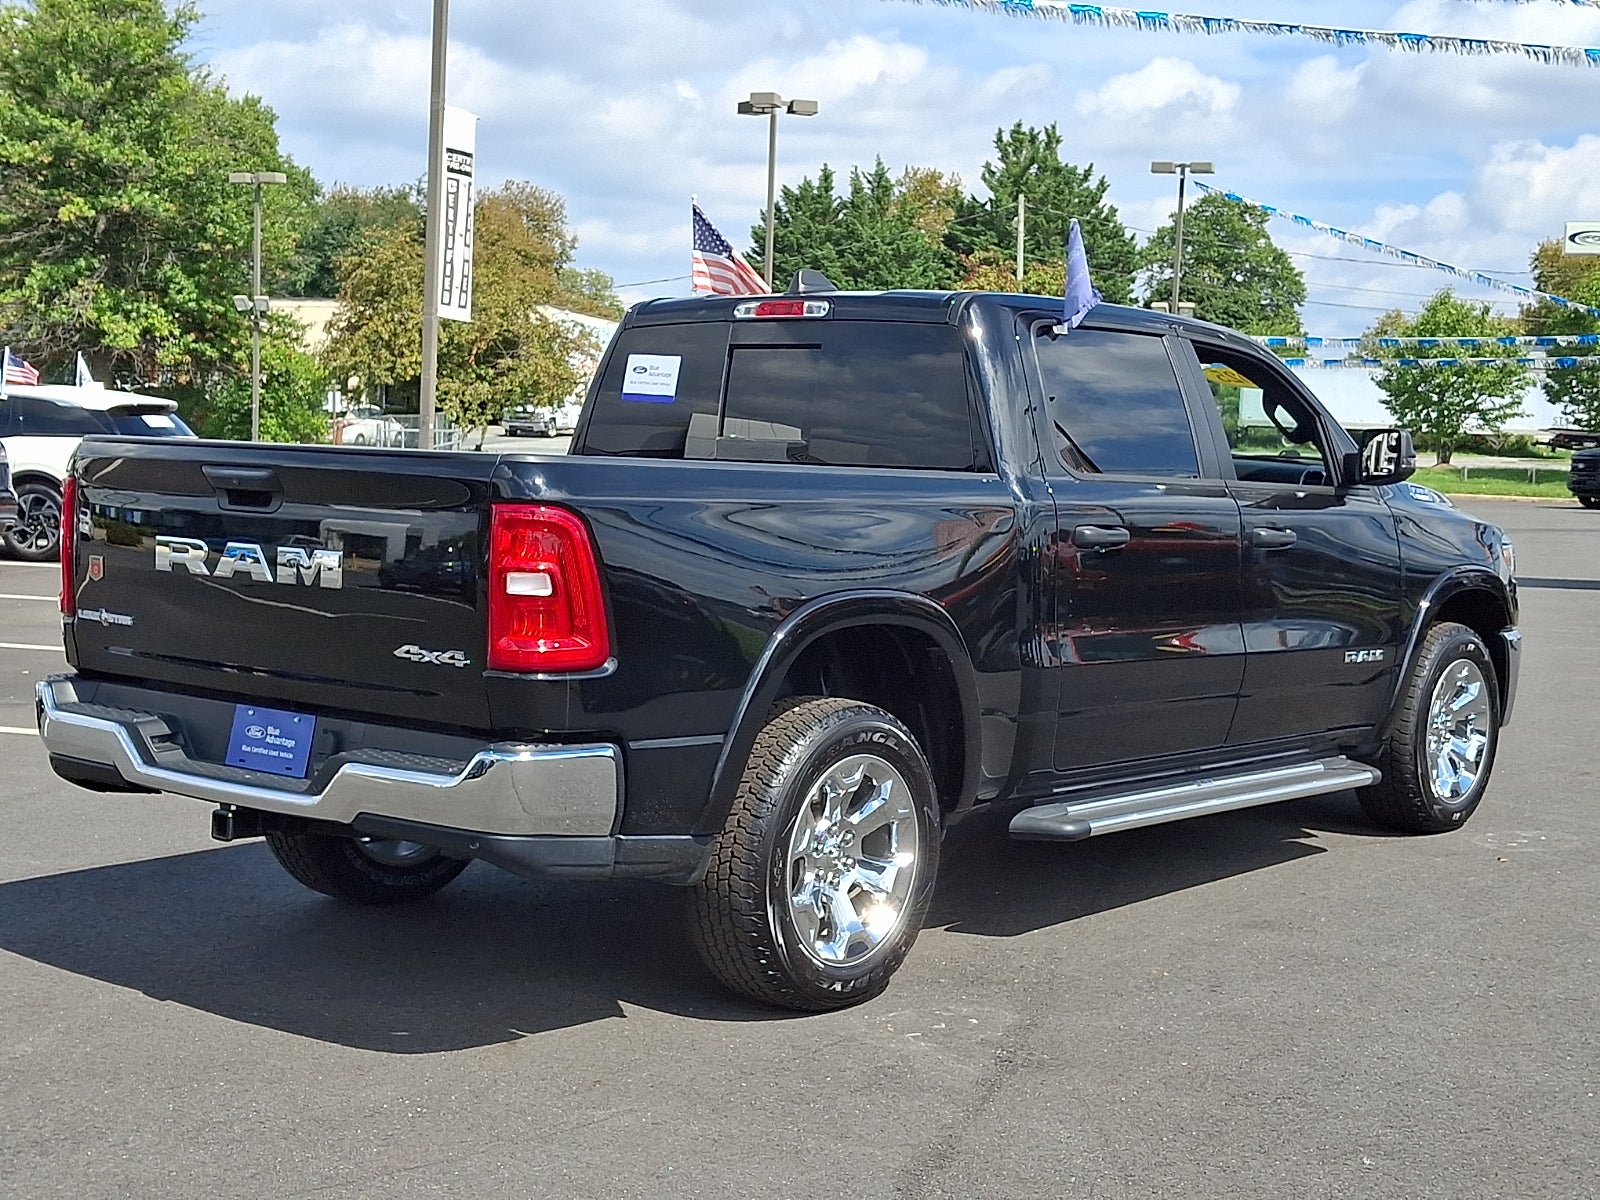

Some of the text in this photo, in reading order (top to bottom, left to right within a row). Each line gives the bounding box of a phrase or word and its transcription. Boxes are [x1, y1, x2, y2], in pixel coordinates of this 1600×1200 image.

[155, 535, 344, 590] RAM
[392, 644, 471, 668] 4x4
[1344, 649, 1384, 663] RAM
[267, 725, 281, 736] Blue
[265, 734, 296, 748] Advantage
[241, 744, 294, 759] Blue Certified Used Vehicle
